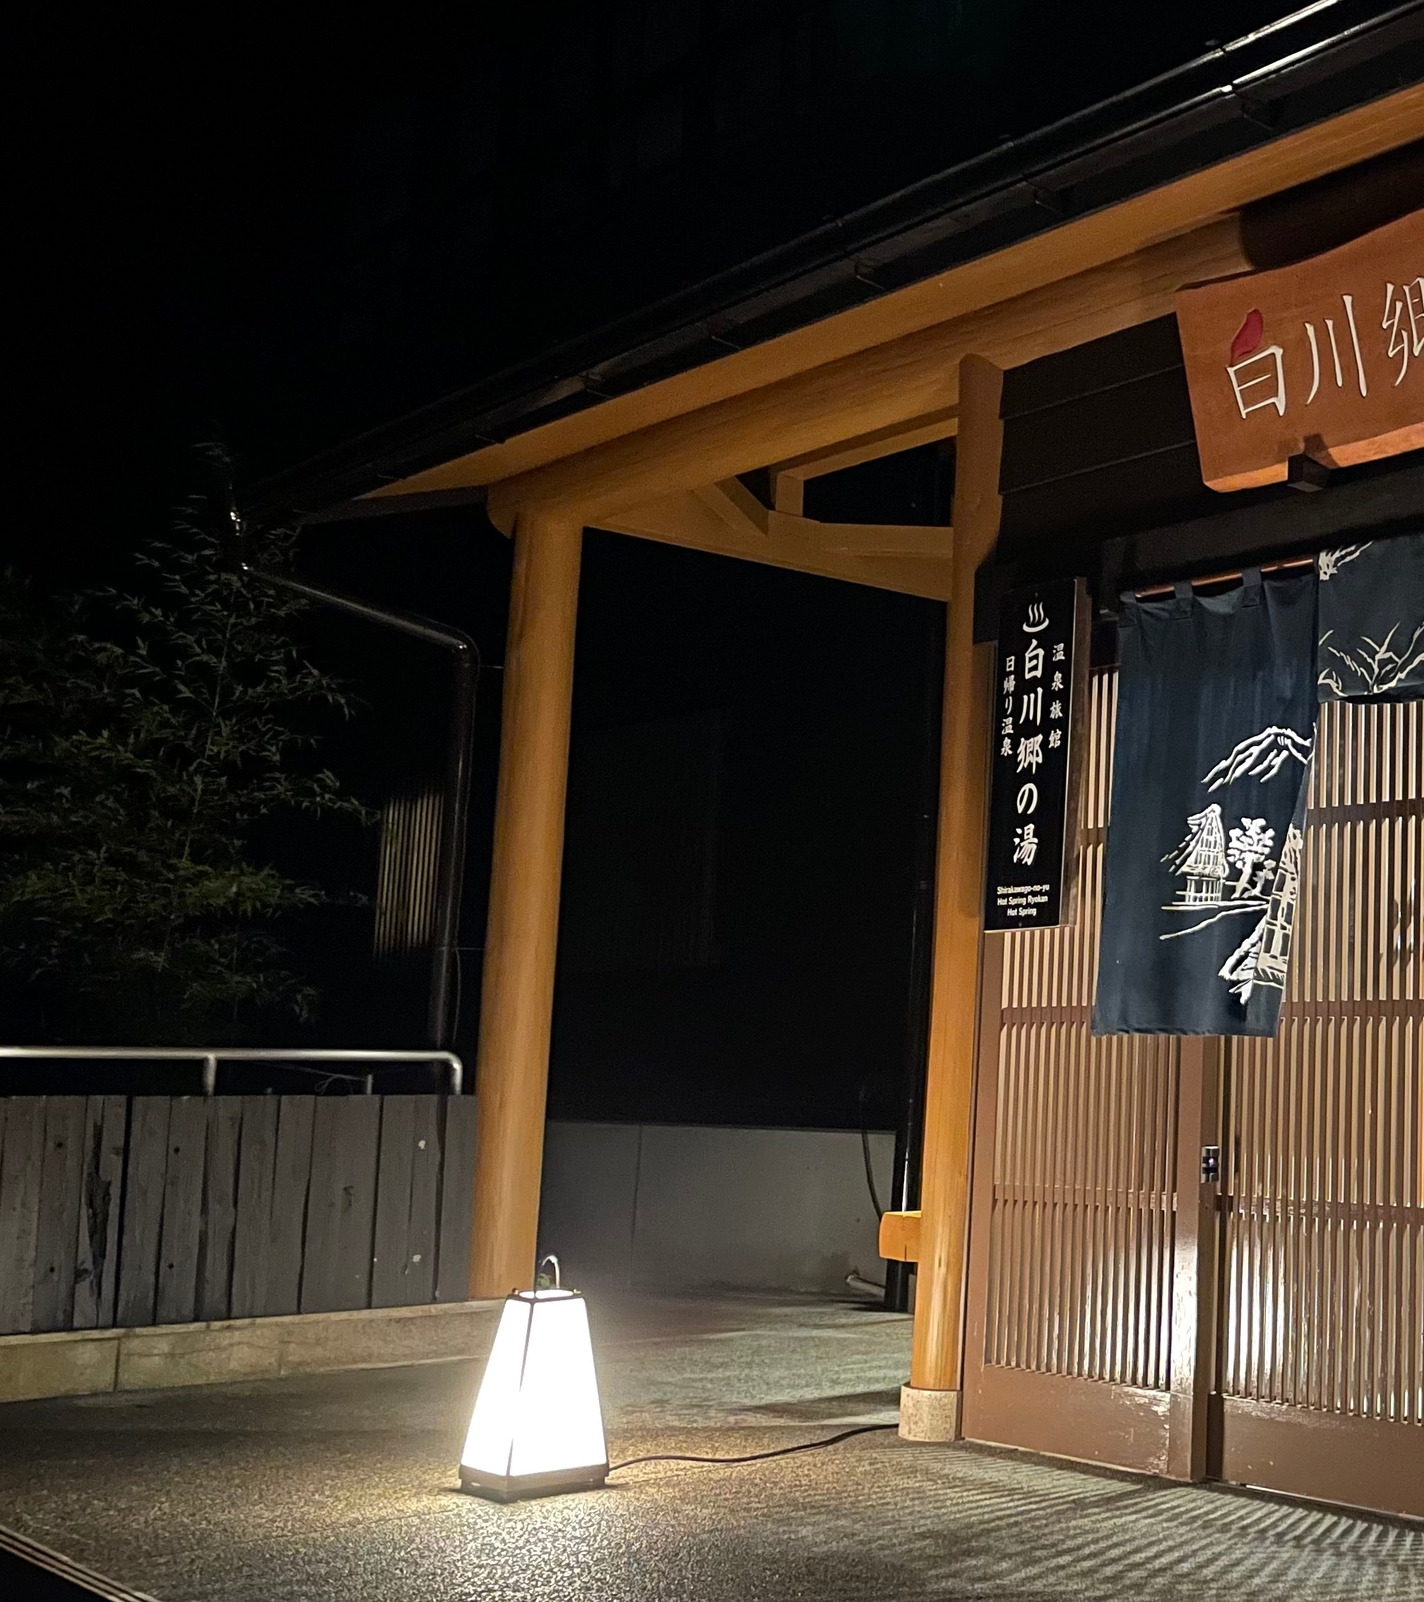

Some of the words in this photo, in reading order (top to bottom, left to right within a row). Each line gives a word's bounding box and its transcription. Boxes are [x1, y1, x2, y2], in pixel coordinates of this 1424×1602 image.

[1000, 655, 1016, 757] 日帰り温泉
[1048, 643, 1065, 749] 温泉旅館
[1013, 639, 1045, 866] 白川郷の湯
[997, 897, 1007, 906] Hot
[1008, 896, 1026, 906] Spring
[1007, 908, 1017, 916] Hot
[1018, 907, 1037, 917] Spring
